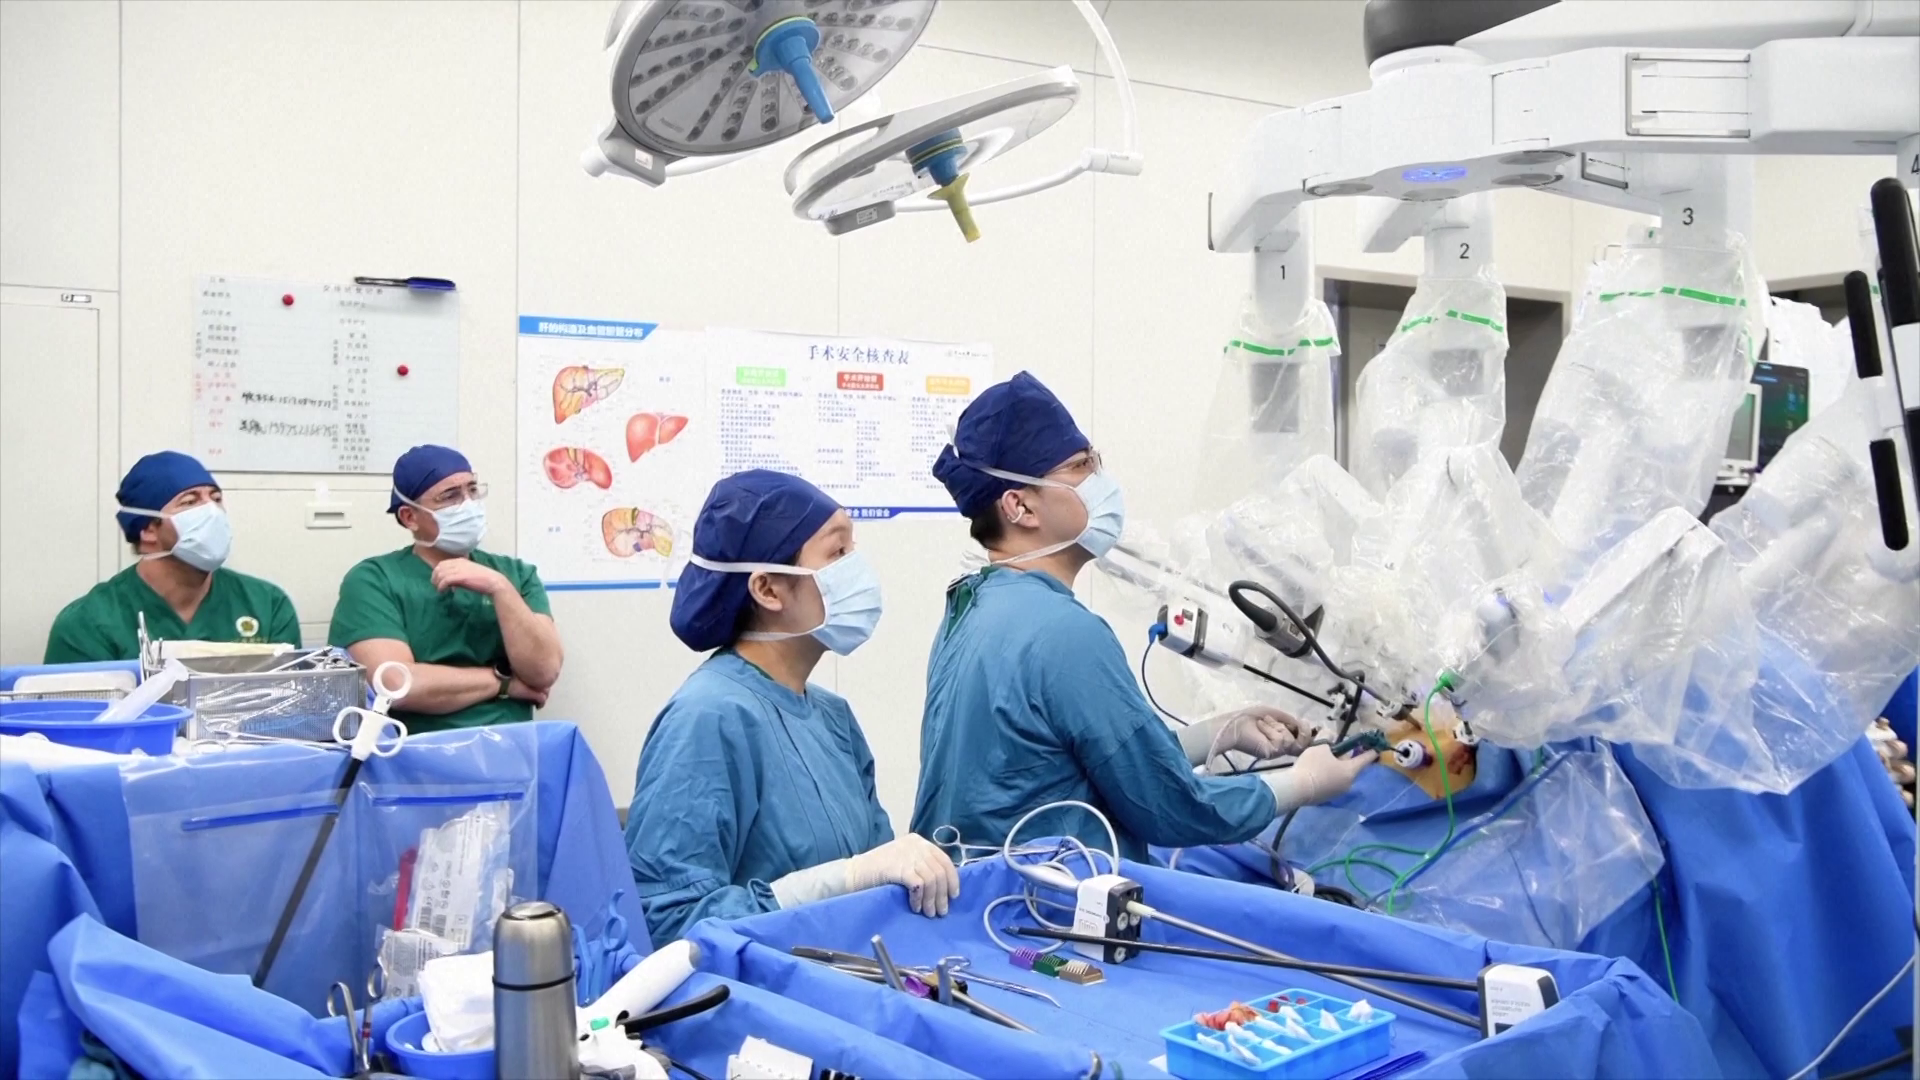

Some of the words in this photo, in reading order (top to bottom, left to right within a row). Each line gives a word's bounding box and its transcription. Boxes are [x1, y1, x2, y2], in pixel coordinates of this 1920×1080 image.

[1911, 154, 1920, 175] 4
[1682, 207, 1694, 226] 3
[1459, 243, 1470, 260] 2
[1280, 264, 1286, 280] 1
[808, 344, 910, 365] 手术安全核查表
